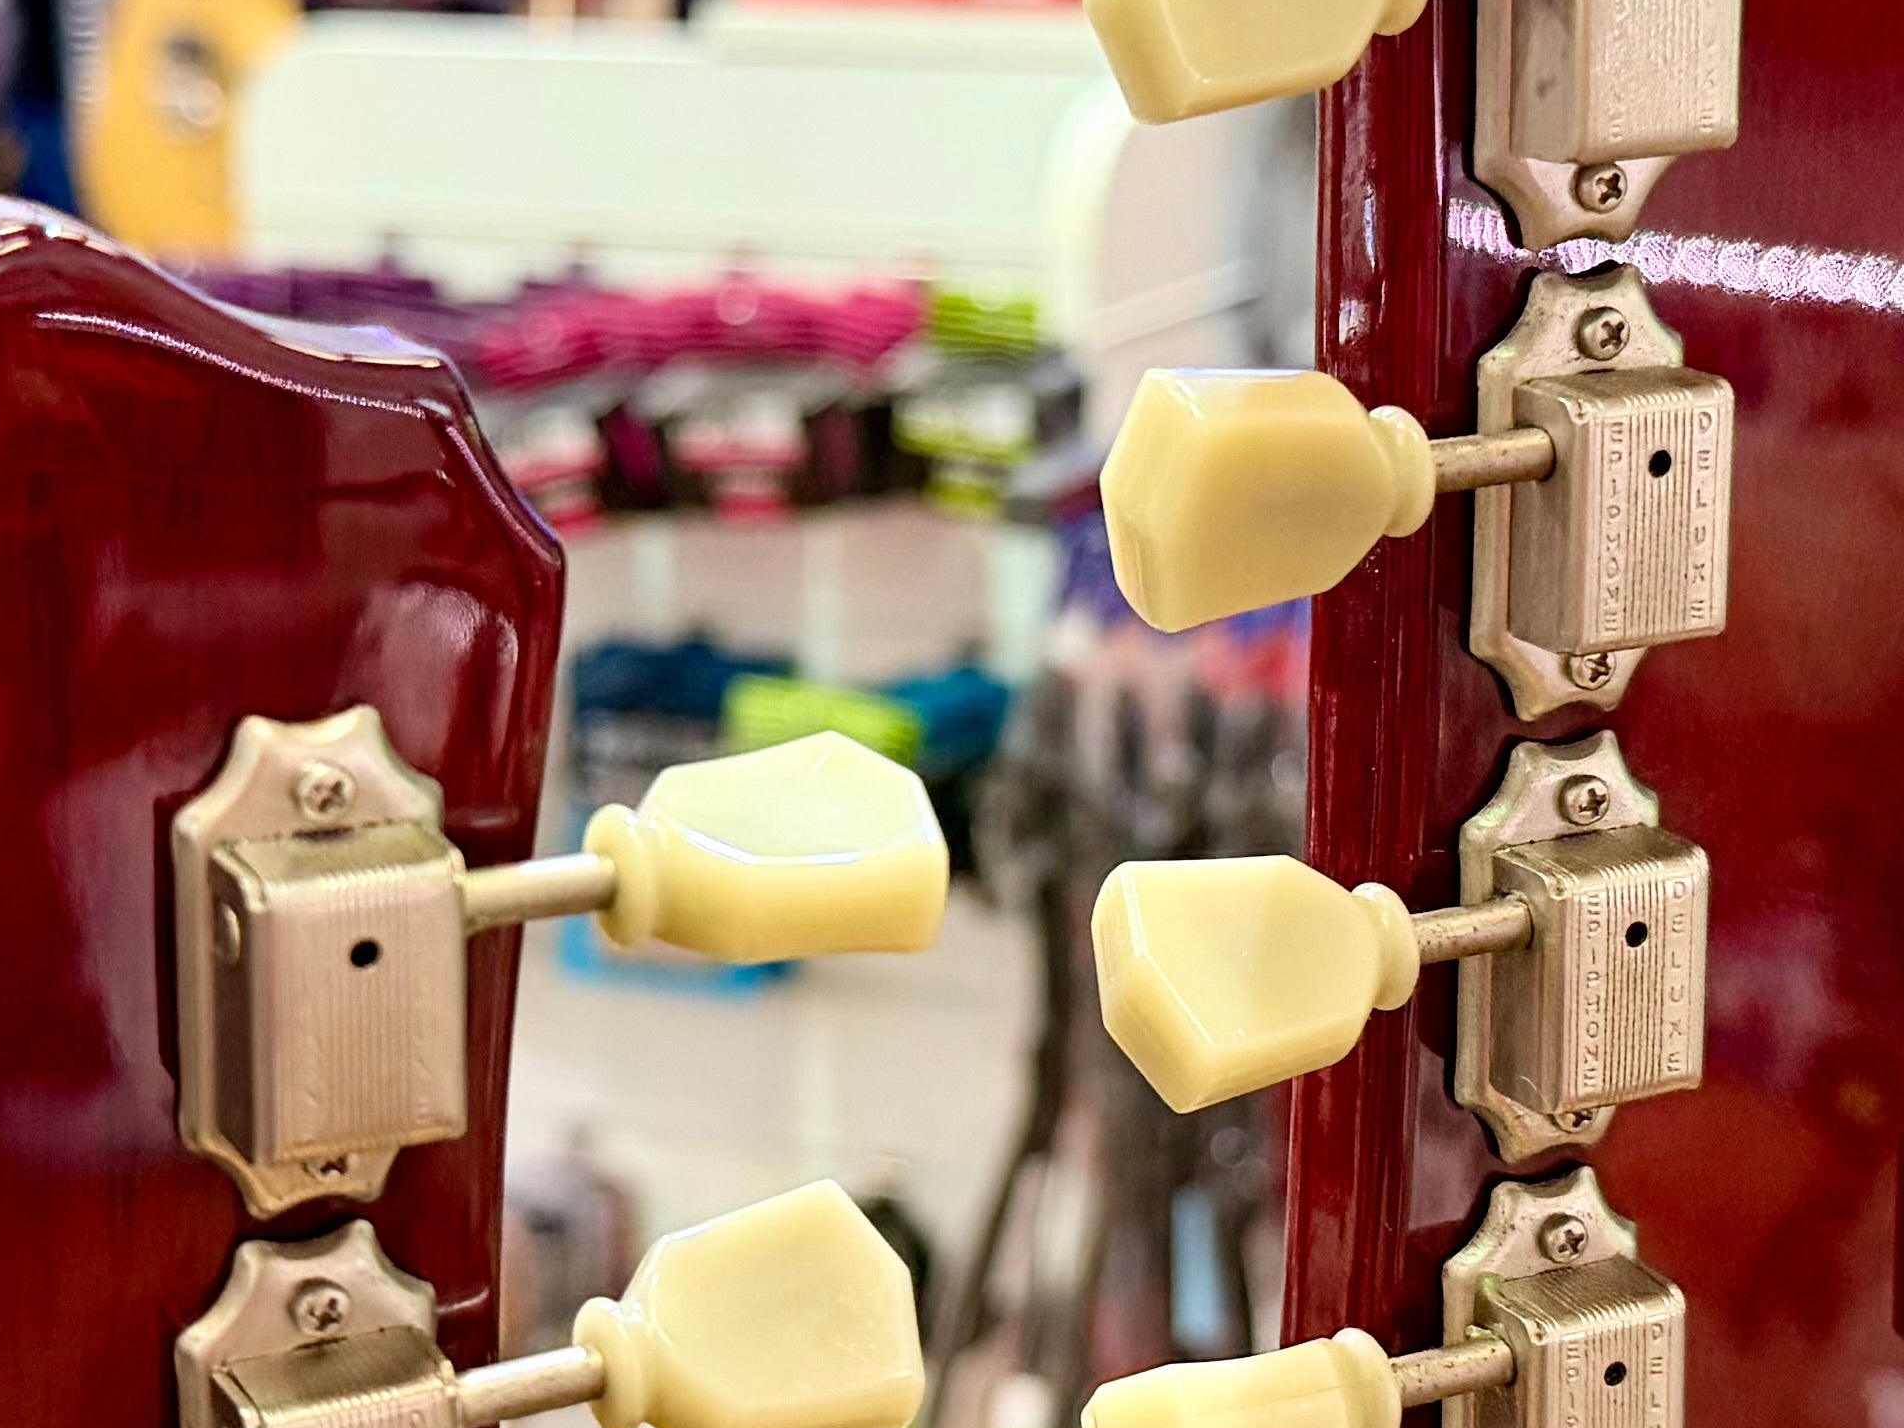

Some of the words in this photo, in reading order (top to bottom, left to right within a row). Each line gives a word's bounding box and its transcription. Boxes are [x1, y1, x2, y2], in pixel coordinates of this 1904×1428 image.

[1602, 419, 1624, 633] EPIPHONE
[1690, 409, 1714, 620] DELUXE
[1580, 891, 1603, 1093] EPIPHONE
[1665, 878, 1690, 1075] DELUXE
